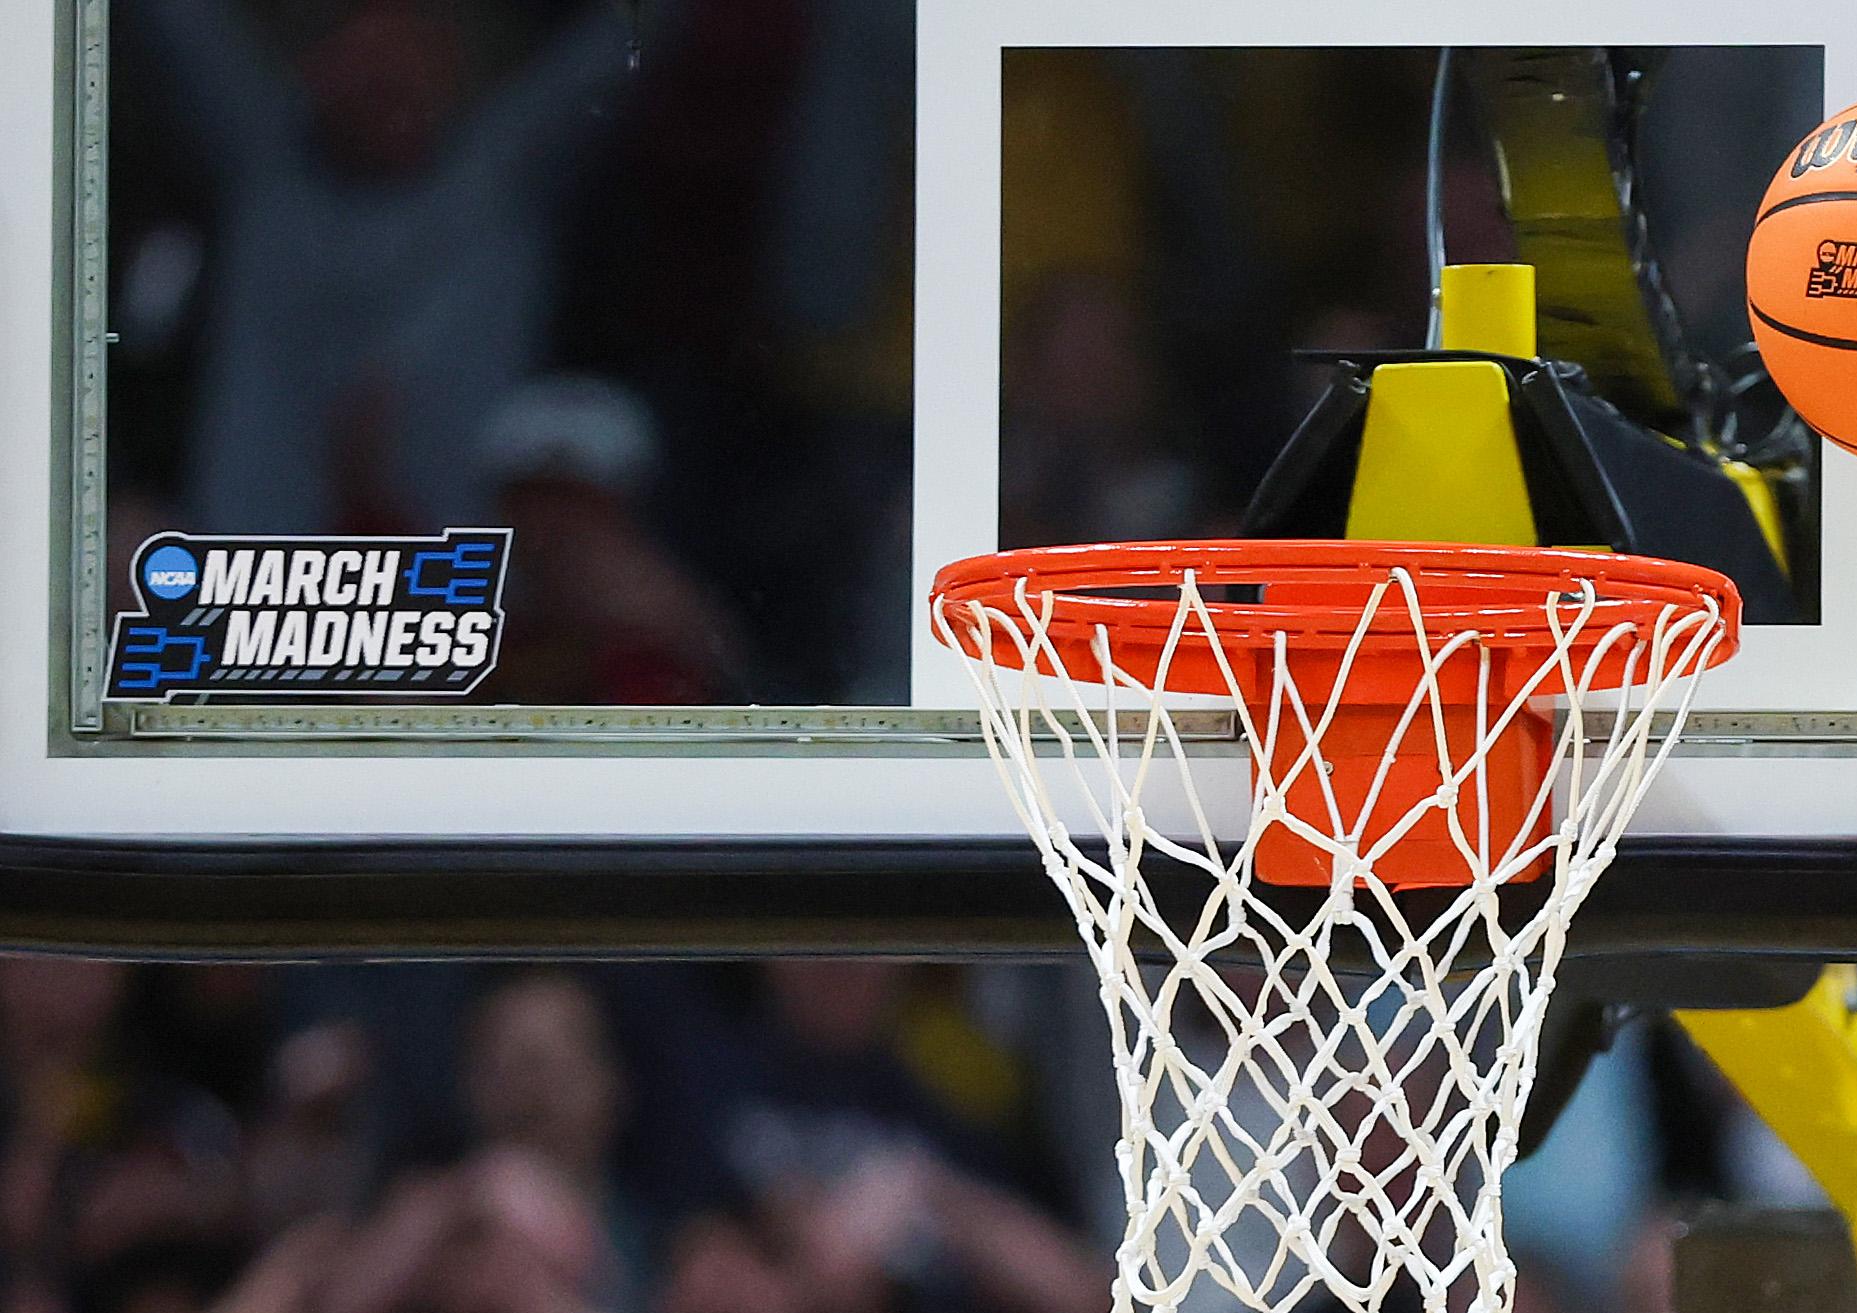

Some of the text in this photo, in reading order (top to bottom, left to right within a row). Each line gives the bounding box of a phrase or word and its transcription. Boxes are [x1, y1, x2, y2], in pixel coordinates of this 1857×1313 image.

[149, 570, 196, 586] NCAA
[198, 549, 401, 606] MARCH
[221, 610, 493, 667] MADNESS
